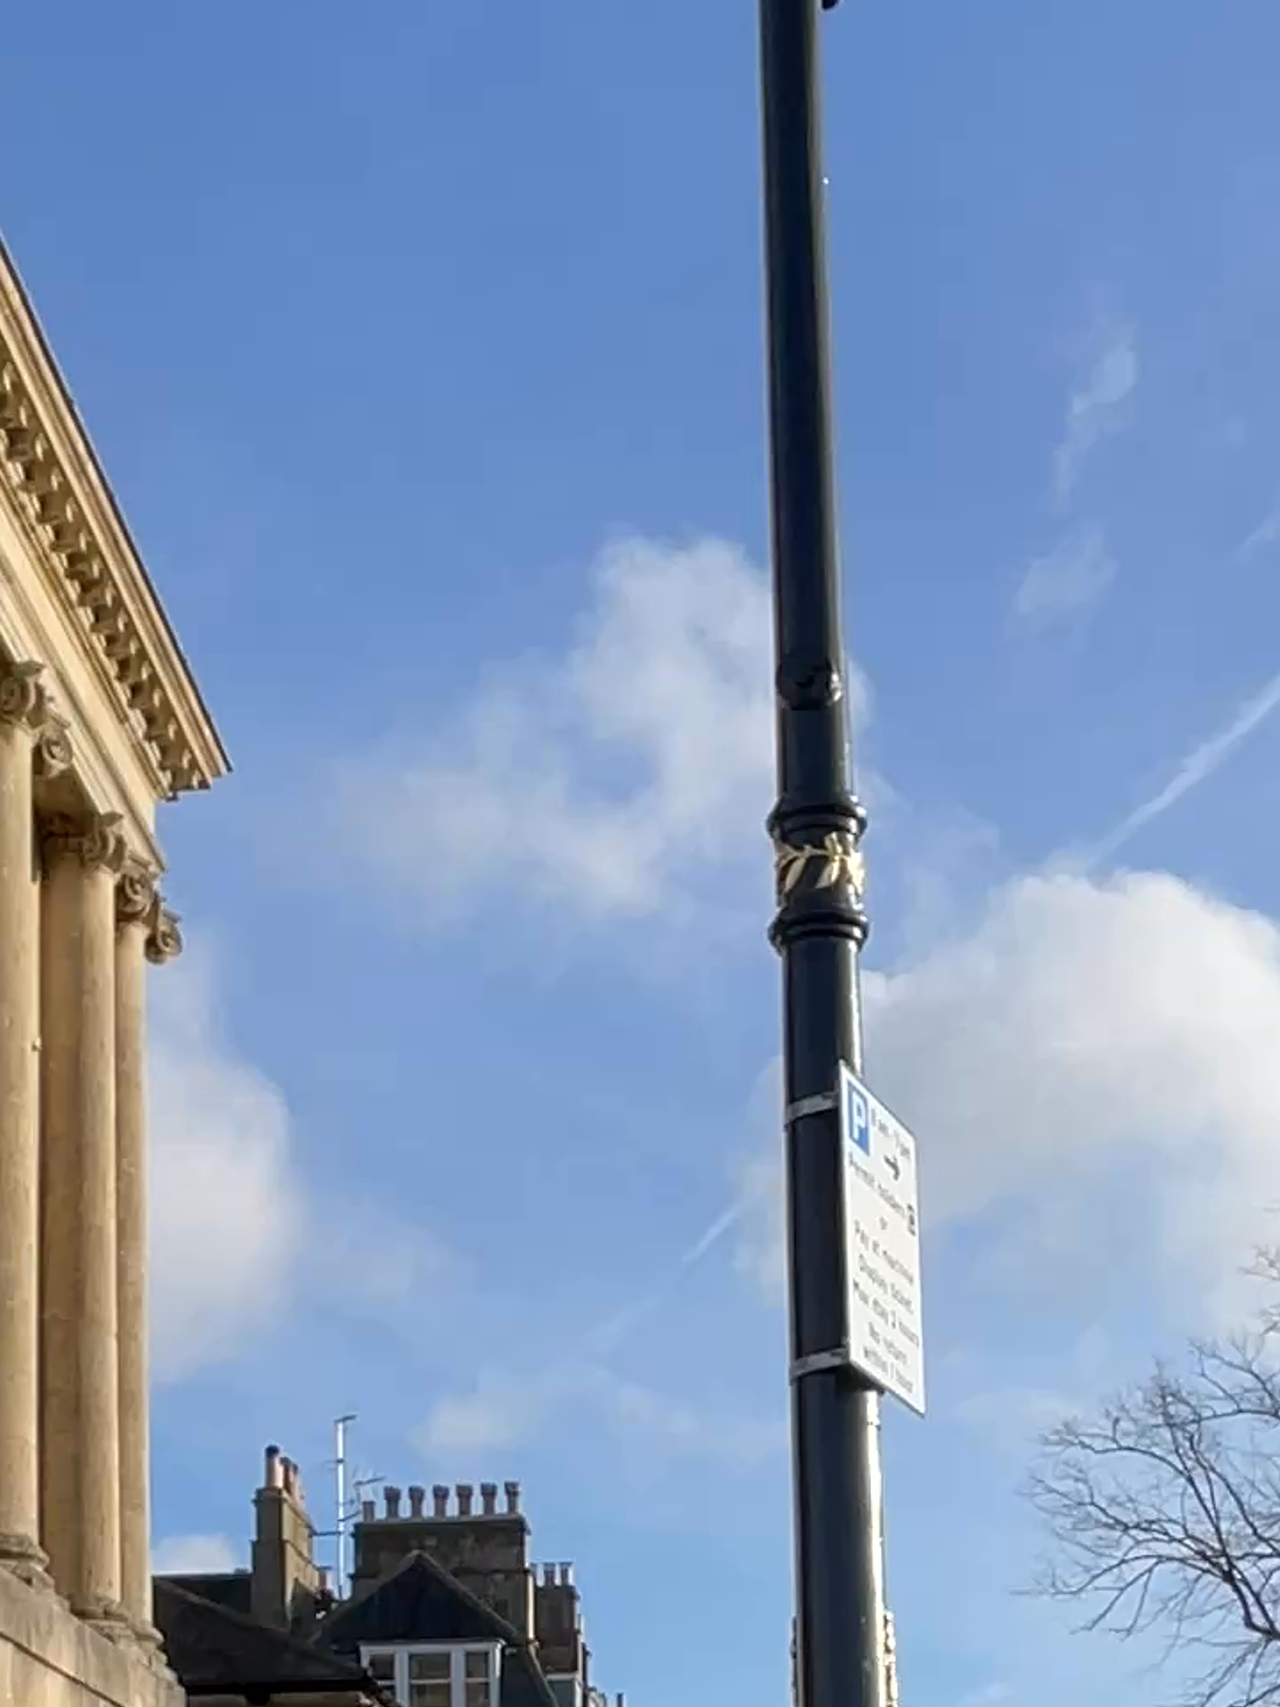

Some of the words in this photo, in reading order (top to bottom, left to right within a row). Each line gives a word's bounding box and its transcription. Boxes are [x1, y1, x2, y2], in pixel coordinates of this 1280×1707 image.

[852, 1091, 866, 1141] P
[848, 1150, 875, 1191] Permit
[877, 1180, 907, 1221] holders
[854, 1219, 869, 1252] Pay
[872, 1239, 881, 1259] at
[882, 1249, 914, 1287] machine
[858, 1252, 888, 1296] Display
[853, 1277, 869, 1306] Max
[872, 1296, 889, 1327] stay
[863, 1346, 888, 1375] within
[868, 1320, 880, 1345] No
[882, 1335, 907, 1366] return
